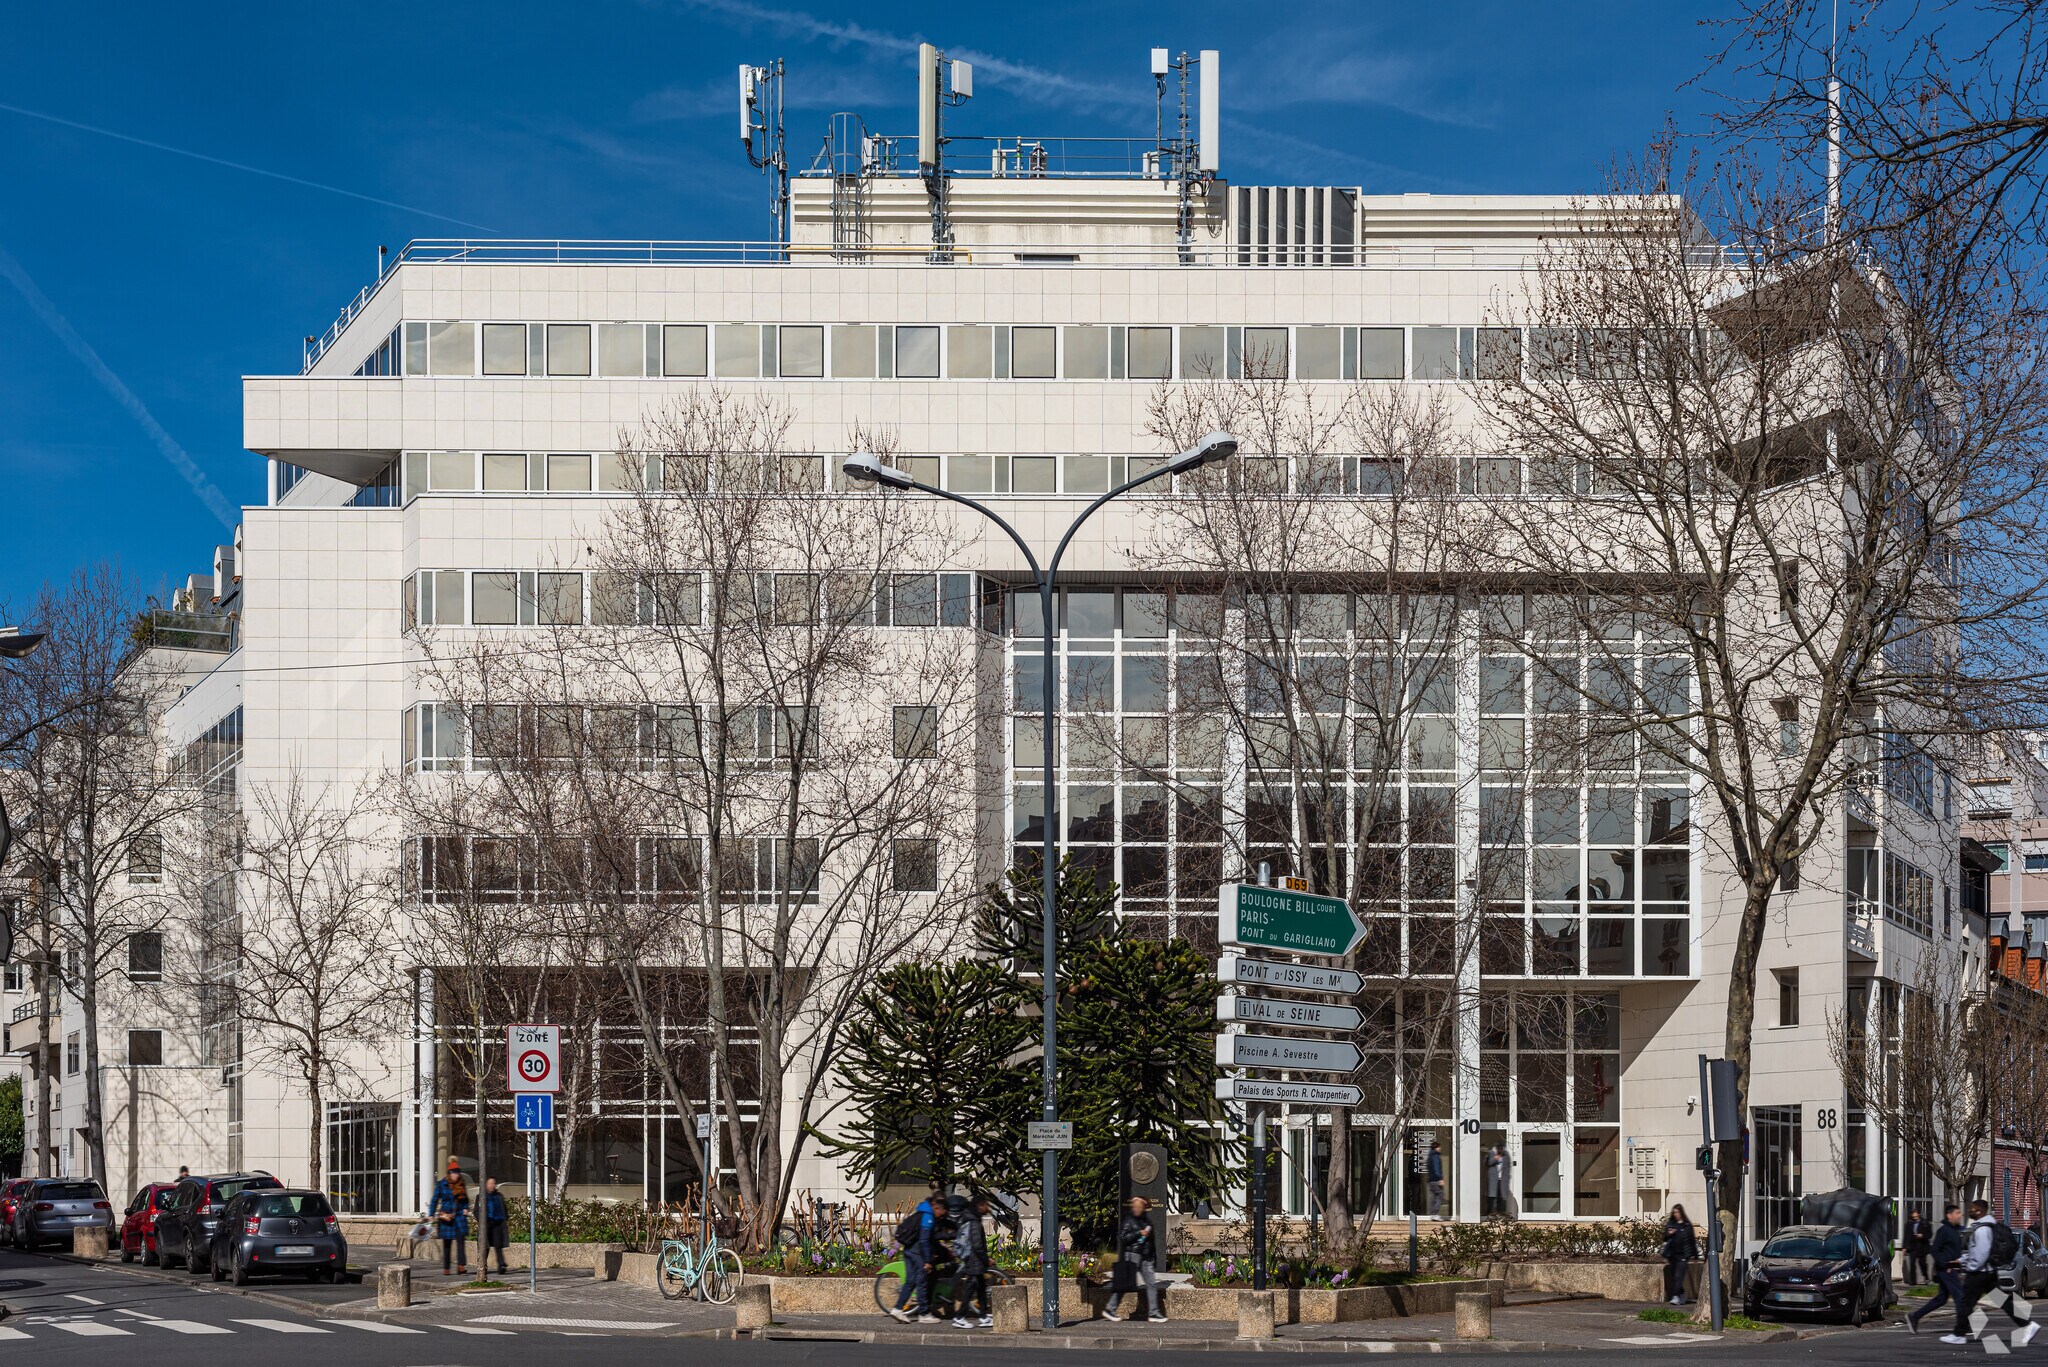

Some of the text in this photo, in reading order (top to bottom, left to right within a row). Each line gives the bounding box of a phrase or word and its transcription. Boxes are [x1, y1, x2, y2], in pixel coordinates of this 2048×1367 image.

[1286, 878, 1307, 892] D 69
[1241, 892, 1292, 911] BOULOGNE
[1241, 926, 1337, 949] PONT DU GARIGLIANO
[1240, 964, 1269, 979] PONT
[1312, 975, 1324, 985] LES
[1252, 1003, 1272, 1017] VAL
[1276, 1009, 1285, 1019] DE
[1290, 1007, 1321, 1022] SEINE
[1238, 1045, 1319, 1060] Piscine A. Sevestre
[525, 1060, 544, 1072] 30
[1238, 1084, 1351, 1101] Palais des Sports R. Charpentier
[1460, 1119, 1480, 1134] 10
[1817, 1108, 1837, 1129] 88
